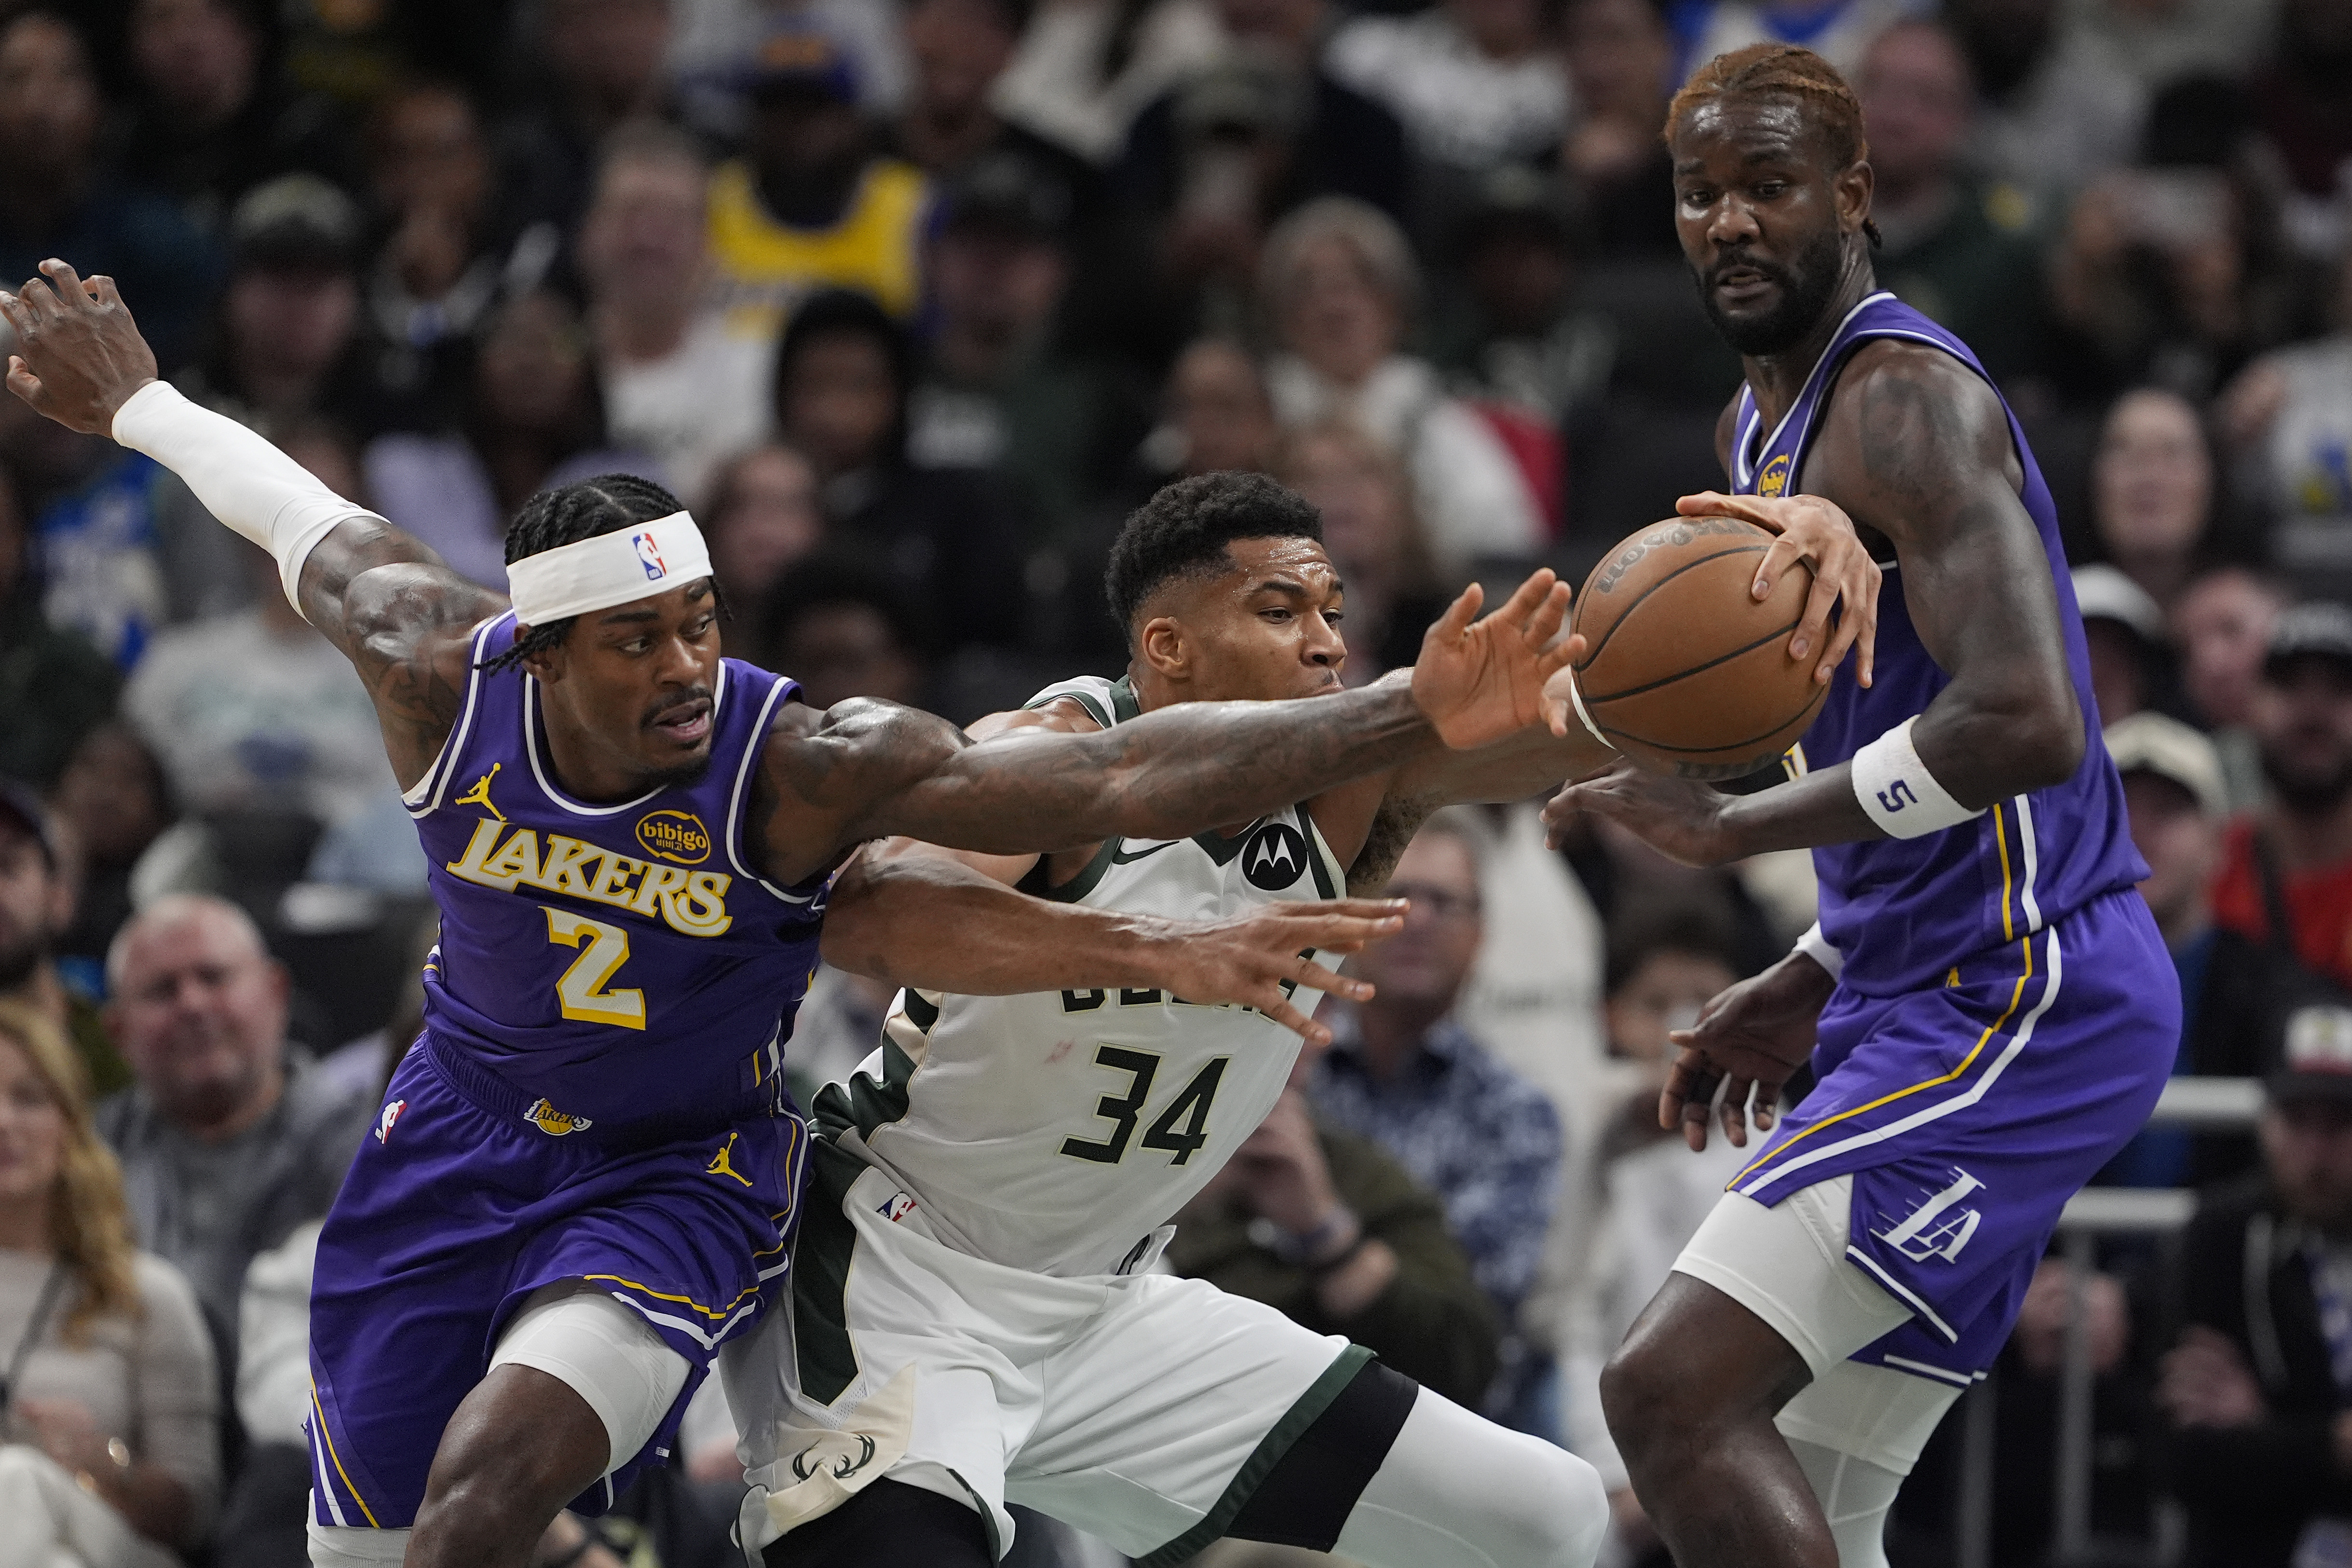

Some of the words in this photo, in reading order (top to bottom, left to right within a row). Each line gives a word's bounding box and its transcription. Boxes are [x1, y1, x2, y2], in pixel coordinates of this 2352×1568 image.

[643, 821, 707, 851] bibigo
[656, 838, 683, 851] 비비고
[1877, 779, 1918, 812] 5
[446, 818, 733, 937] LAKERS
[538, 905, 645, 1030] 2
[1057, 1043, 1232, 1167] 34
[1869, 1165, 1986, 1264] LA
